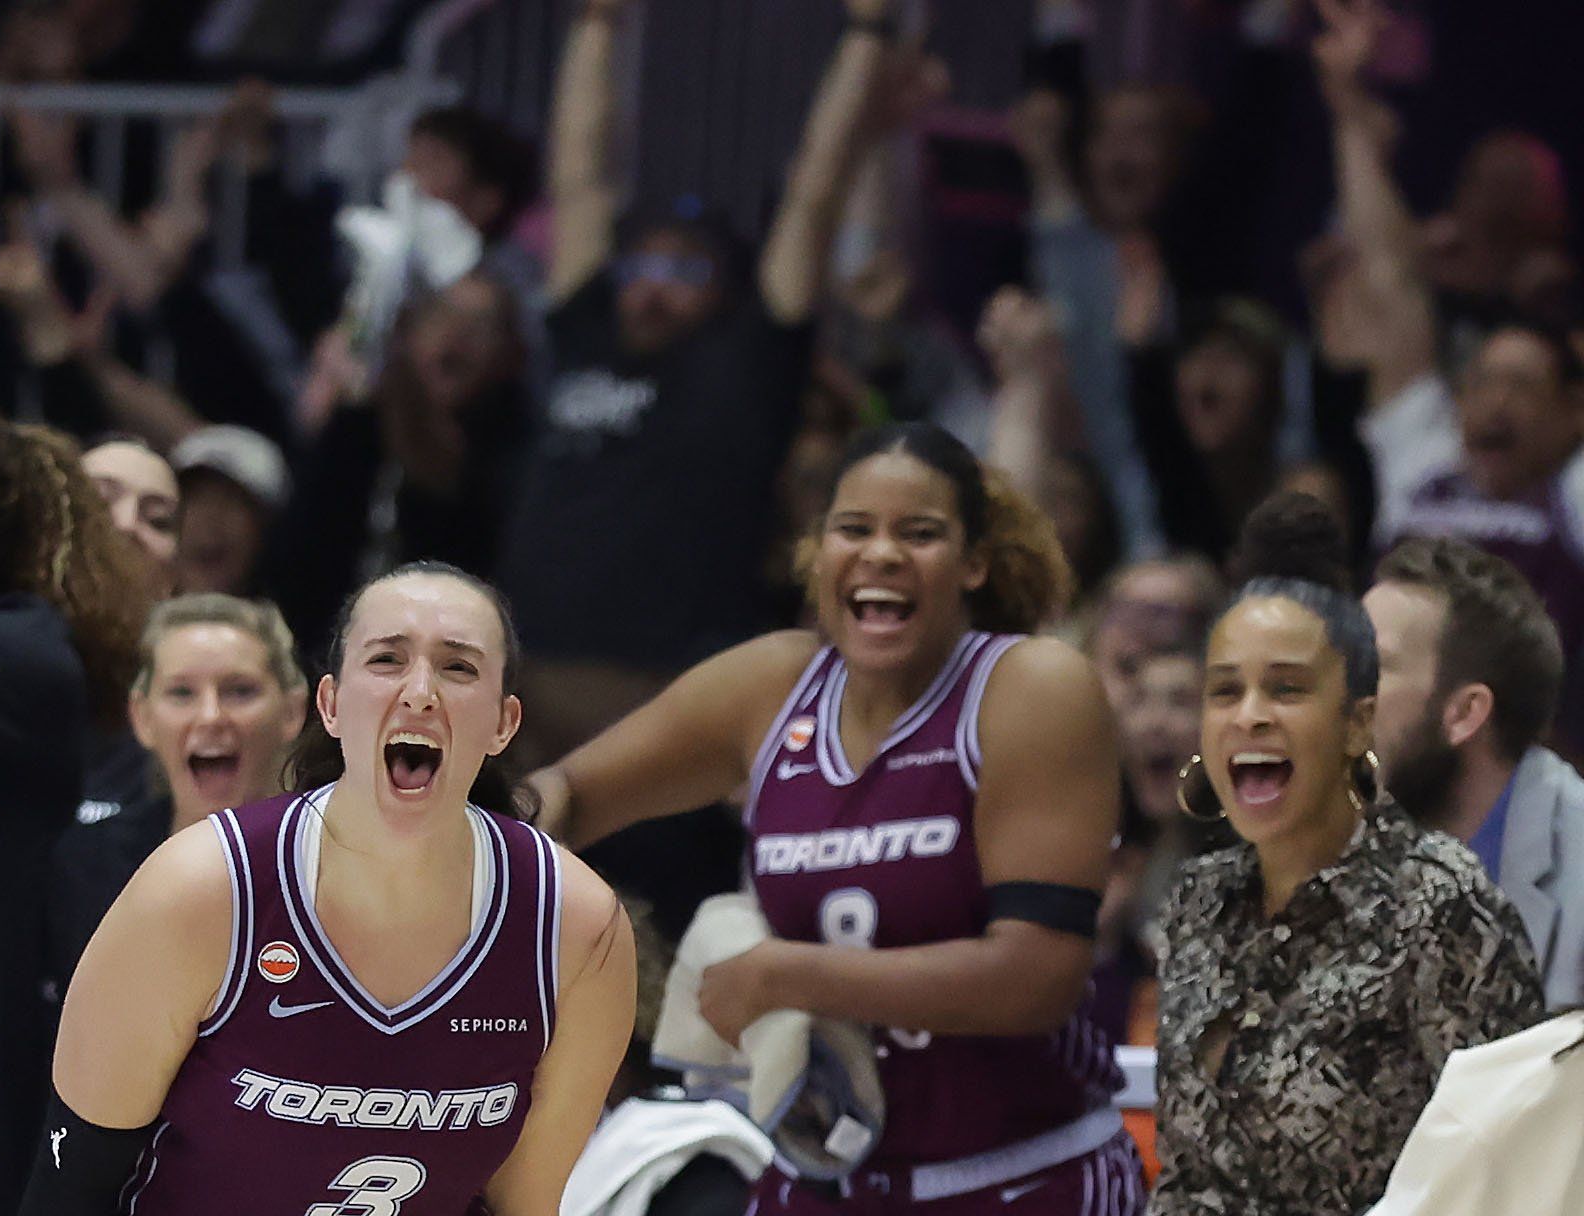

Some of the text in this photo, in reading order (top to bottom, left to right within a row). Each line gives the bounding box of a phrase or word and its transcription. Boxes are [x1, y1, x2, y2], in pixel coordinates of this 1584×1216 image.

[755, 814, 961, 876] TORONTO
[449, 1018, 528, 1032] SEPHORA
[230, 1068, 518, 1131] TORONTO
